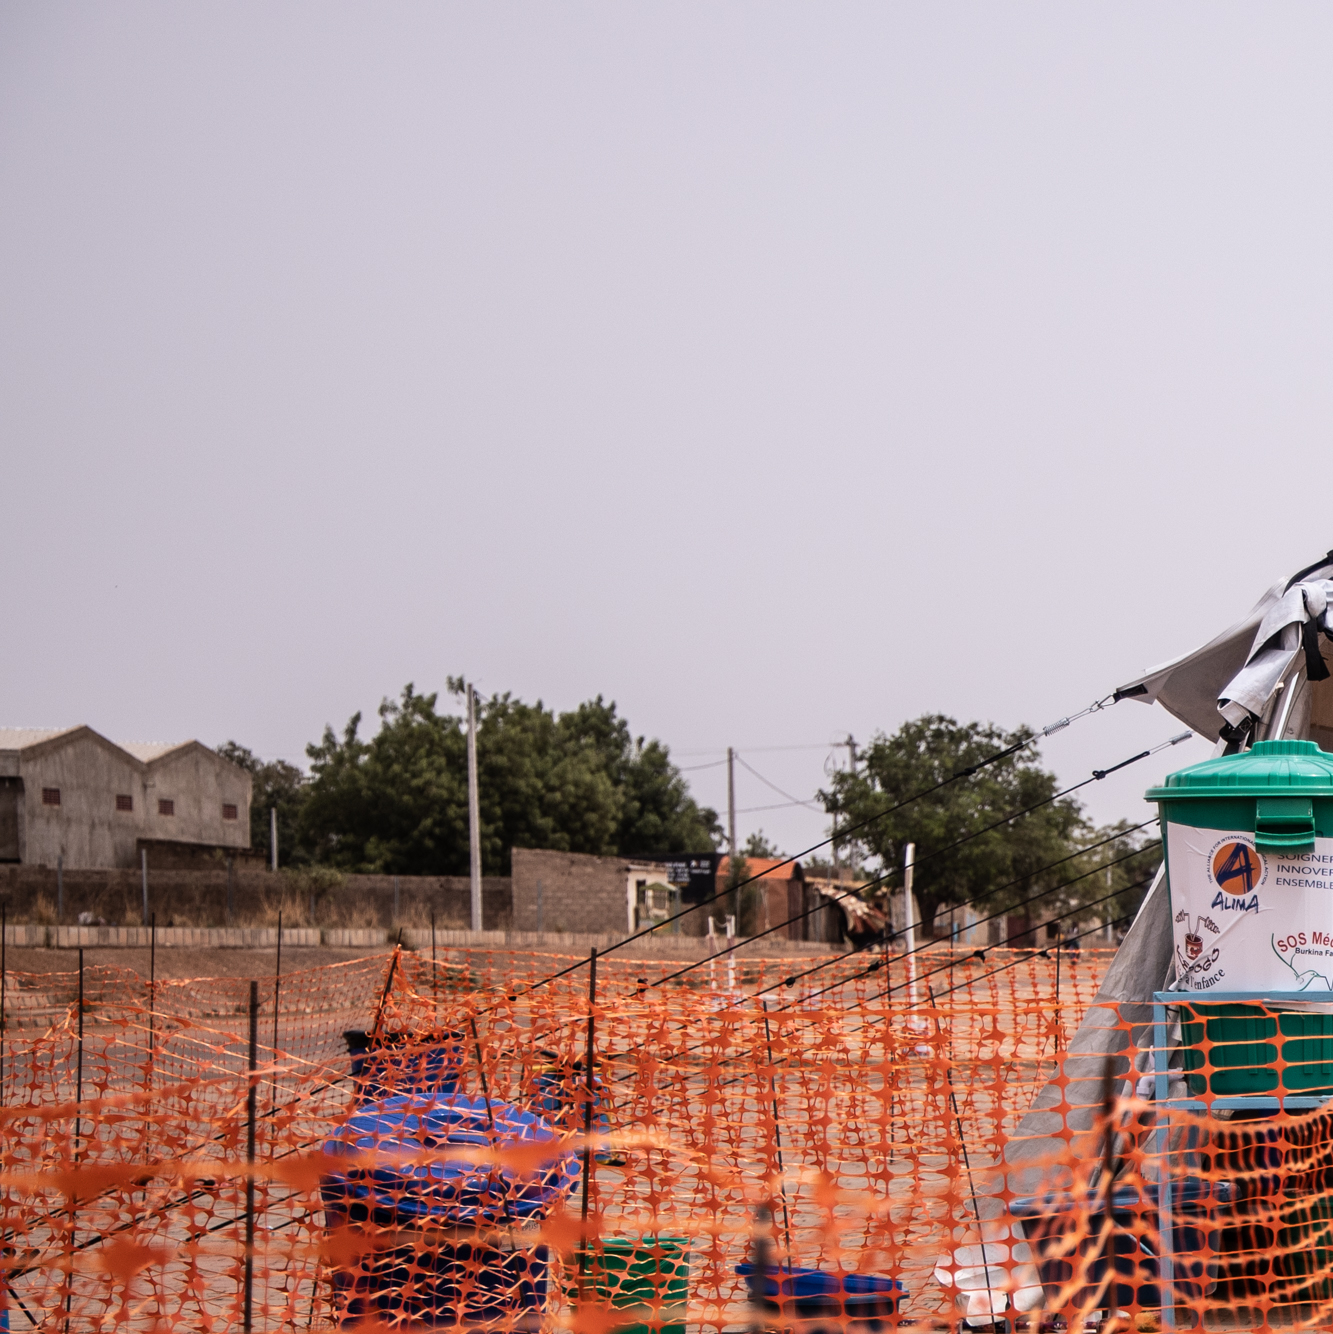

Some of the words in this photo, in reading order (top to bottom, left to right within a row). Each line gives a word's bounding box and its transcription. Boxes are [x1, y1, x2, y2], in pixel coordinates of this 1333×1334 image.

[1212, 840, 1222, 850] FOR
[1211, 891, 1260, 914] ALIMA
[1277, 932, 1307, 953] SOS
[1294, 947, 1323, 956] Burkina
